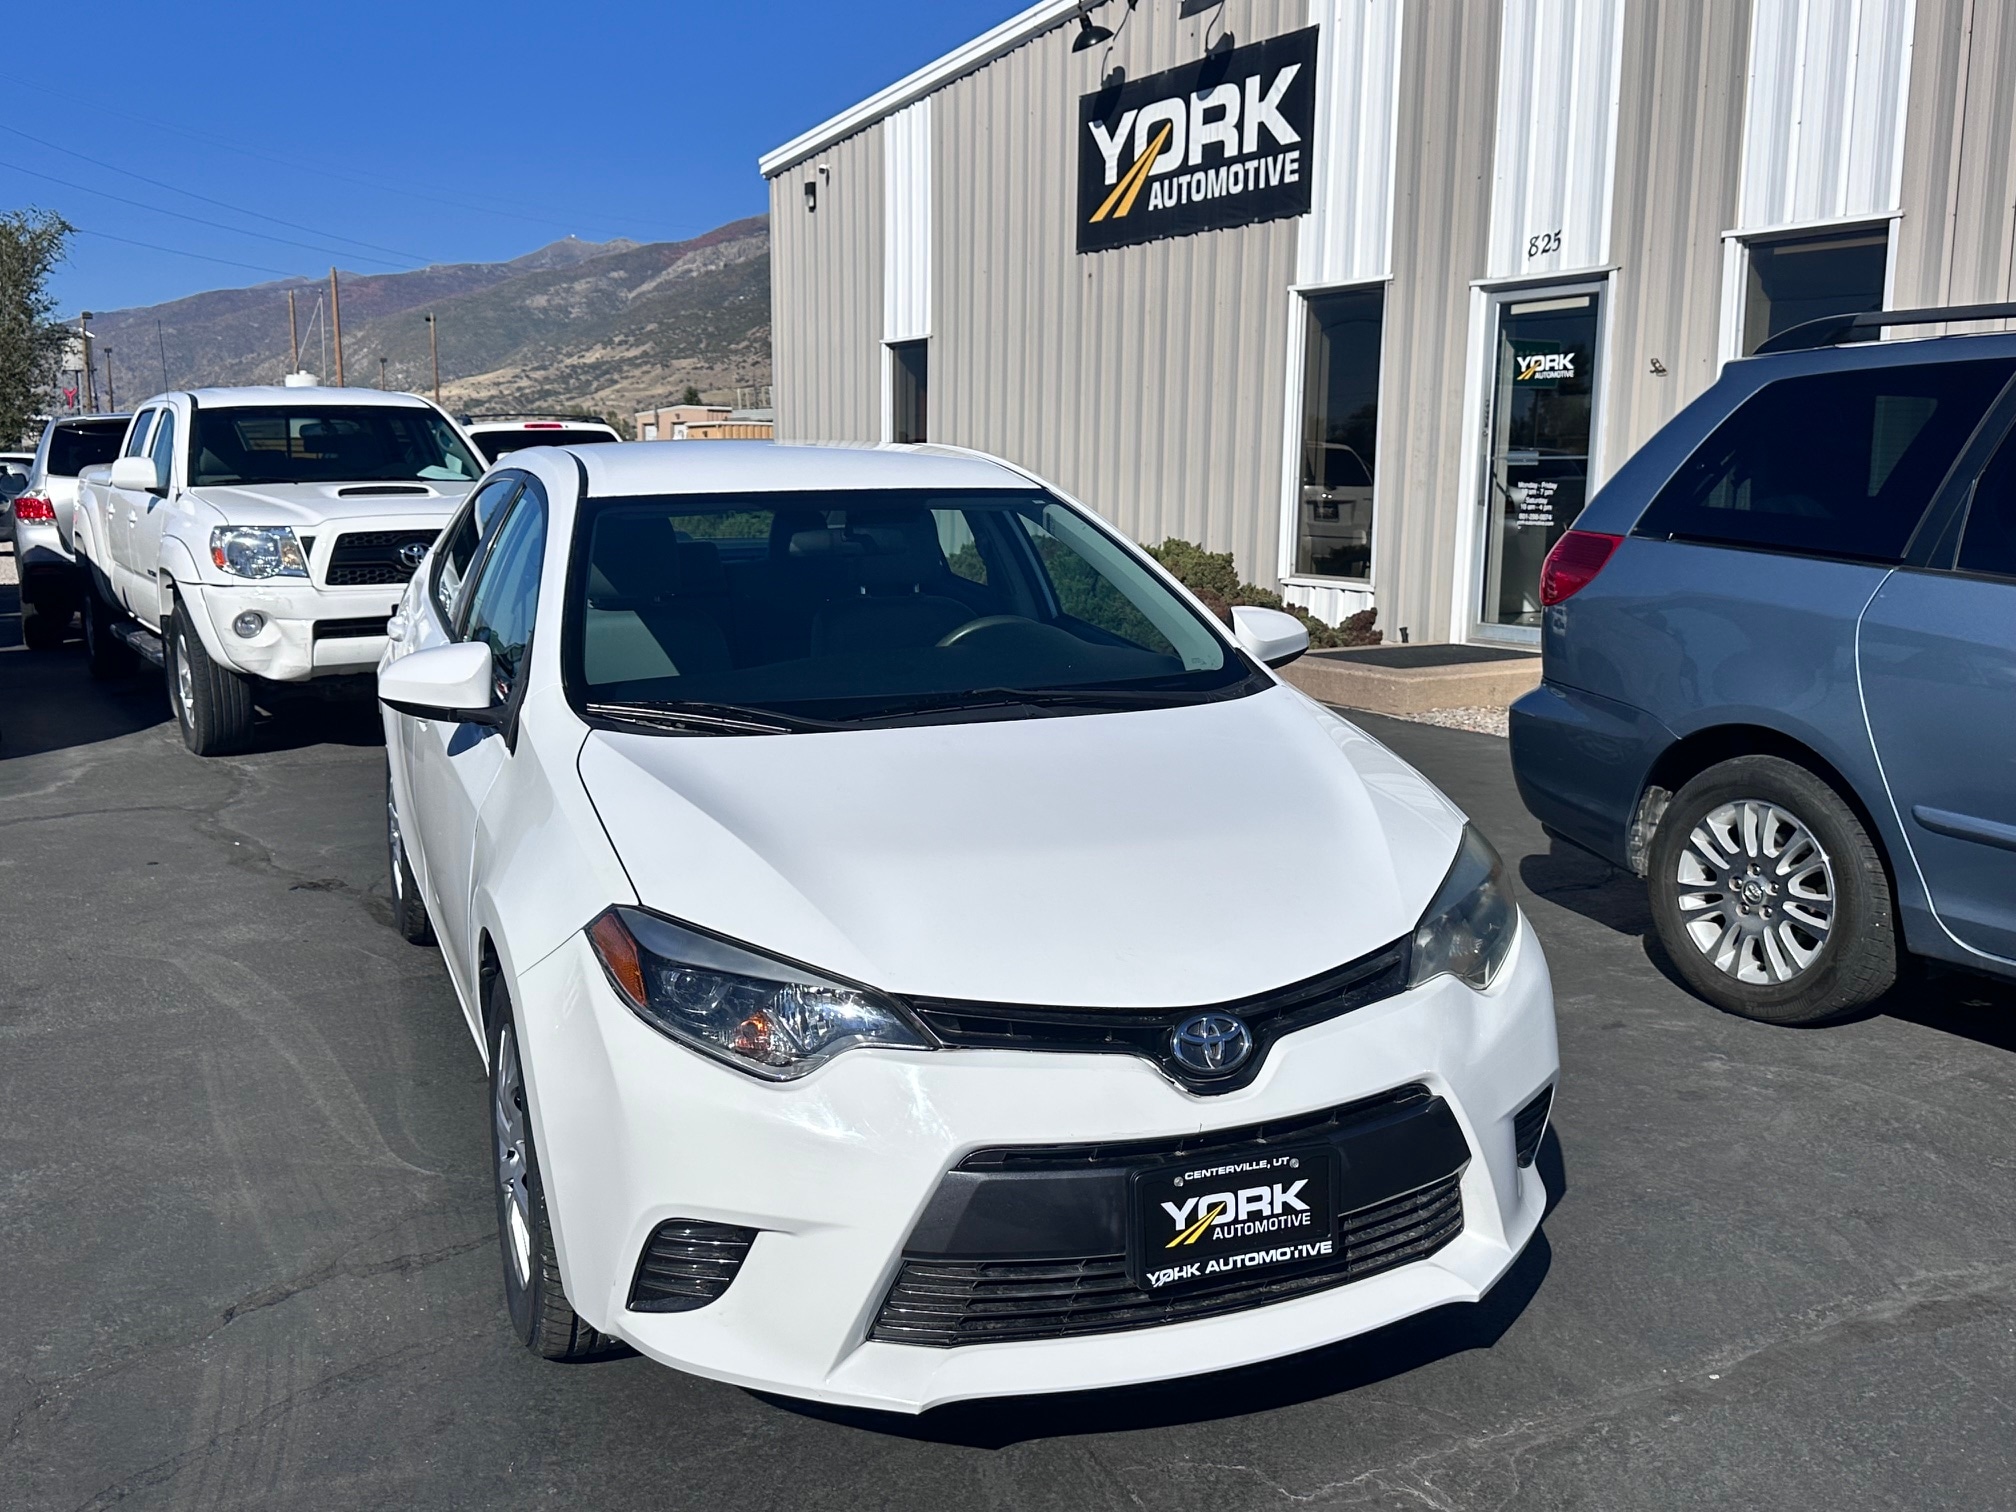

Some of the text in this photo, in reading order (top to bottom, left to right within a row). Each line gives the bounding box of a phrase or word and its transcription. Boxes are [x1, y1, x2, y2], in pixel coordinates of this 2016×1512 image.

[1088, 63, 1301, 185] YORK
[1148, 150, 1300, 211] AUTOMOTIVE
[1528, 229, 1562, 259] 825
[1516, 353, 1575, 372] YORK
[1534, 369, 1575, 379] AUTOMOTIVE
[1184, 1156, 1290, 1180] CENTERVILLE, UT
[1160, 1179, 1310, 1231] YORK
[1212, 1212, 1311, 1241] AUTOMOTIVE
[1204, 1240, 1333, 1275] AUTOMOTIVE
